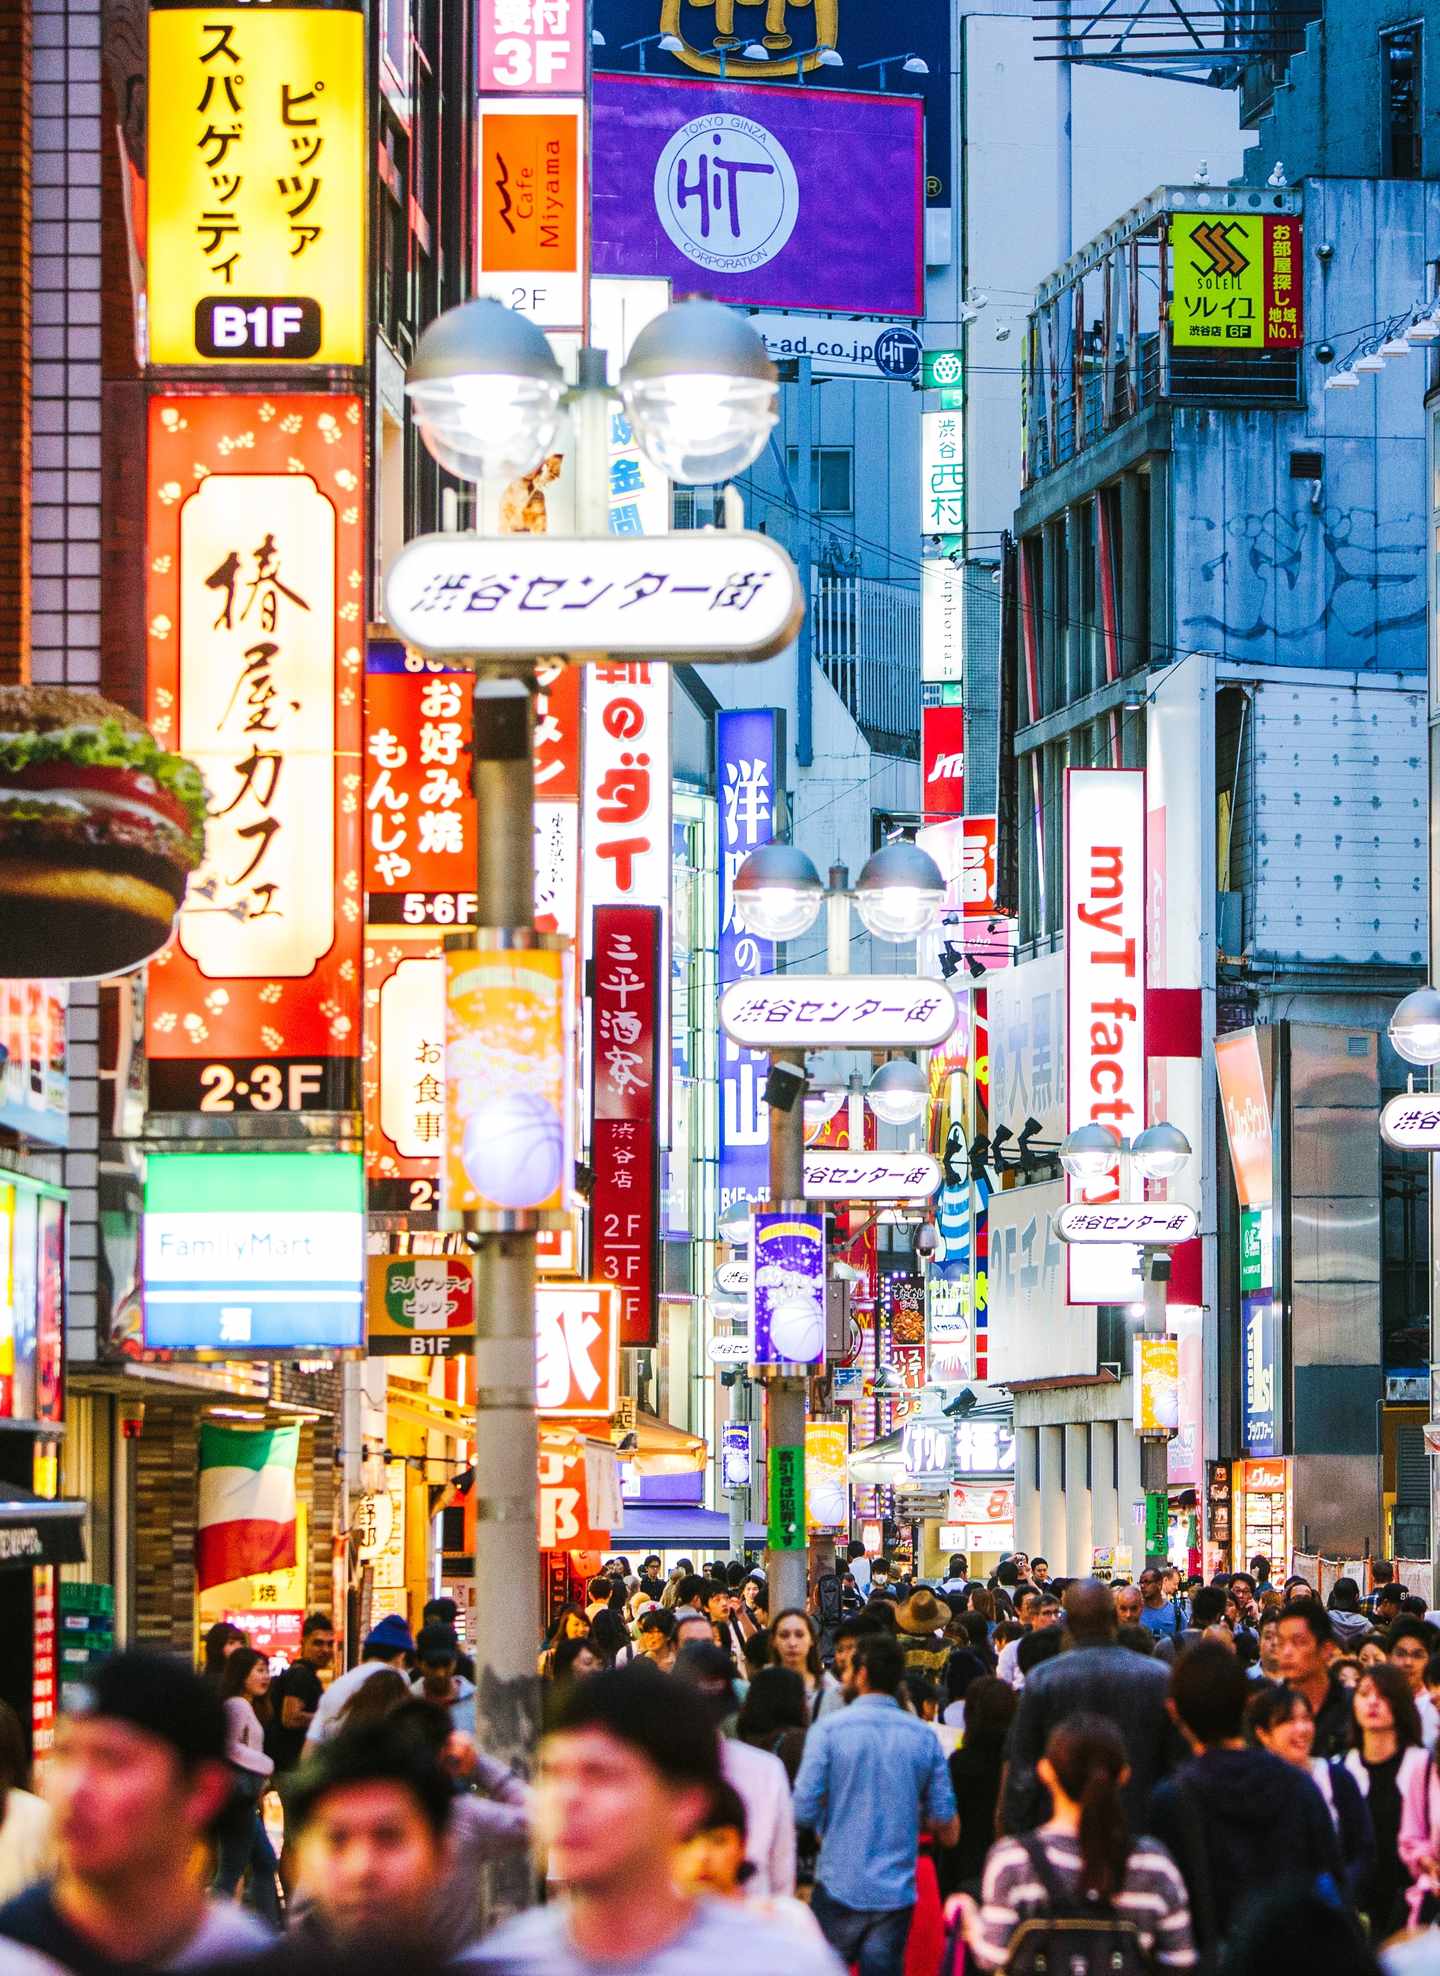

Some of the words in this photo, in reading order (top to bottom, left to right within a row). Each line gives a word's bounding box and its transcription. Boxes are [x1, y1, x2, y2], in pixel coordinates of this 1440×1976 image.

[493, 40, 570, 85] 3F
[682, 116, 724, 138] TOKYO
[731, 117, 767, 143] GINZA
[196, 23, 245, 285] スパゲッティ
[276, 80, 325, 257] ピッツァ
[516, 166, 534, 219] Cafe
[540, 140, 563, 248] Miyama
[683, 242, 769, 269] CORPORATION
[1273, 224, 1292, 306] お部屋探し
[1197, 275, 1242, 290] SOLEIL
[511, 288, 548, 311] 2F
[1183, 296, 1256, 319] ソレイユ
[212, 305, 303, 348] B1F
[1268, 307, 1297, 323] 地域
[1189, 325, 1222, 337] 渋谷店
[1228, 326, 1249, 337] 6F
[1268, 323, 1297, 339] No.1
[410, 570, 774, 613] 渋谷センター街
[204, 532, 312, 920] 椿屋カフェ
[418, 679, 464, 854] お好み焼
[367, 728, 411, 886] もんじゃ
[733, 998, 942, 1023] 渋谷センター街
[610, 1122, 636, 1189] 渋谷店
[603, 1214, 641, 1237] 2F
[1066, 1214, 1189, 1231] 渋谷センター街
[603, 1256, 641, 1279] 3F
[409, 1337, 451, 1356] B1F
